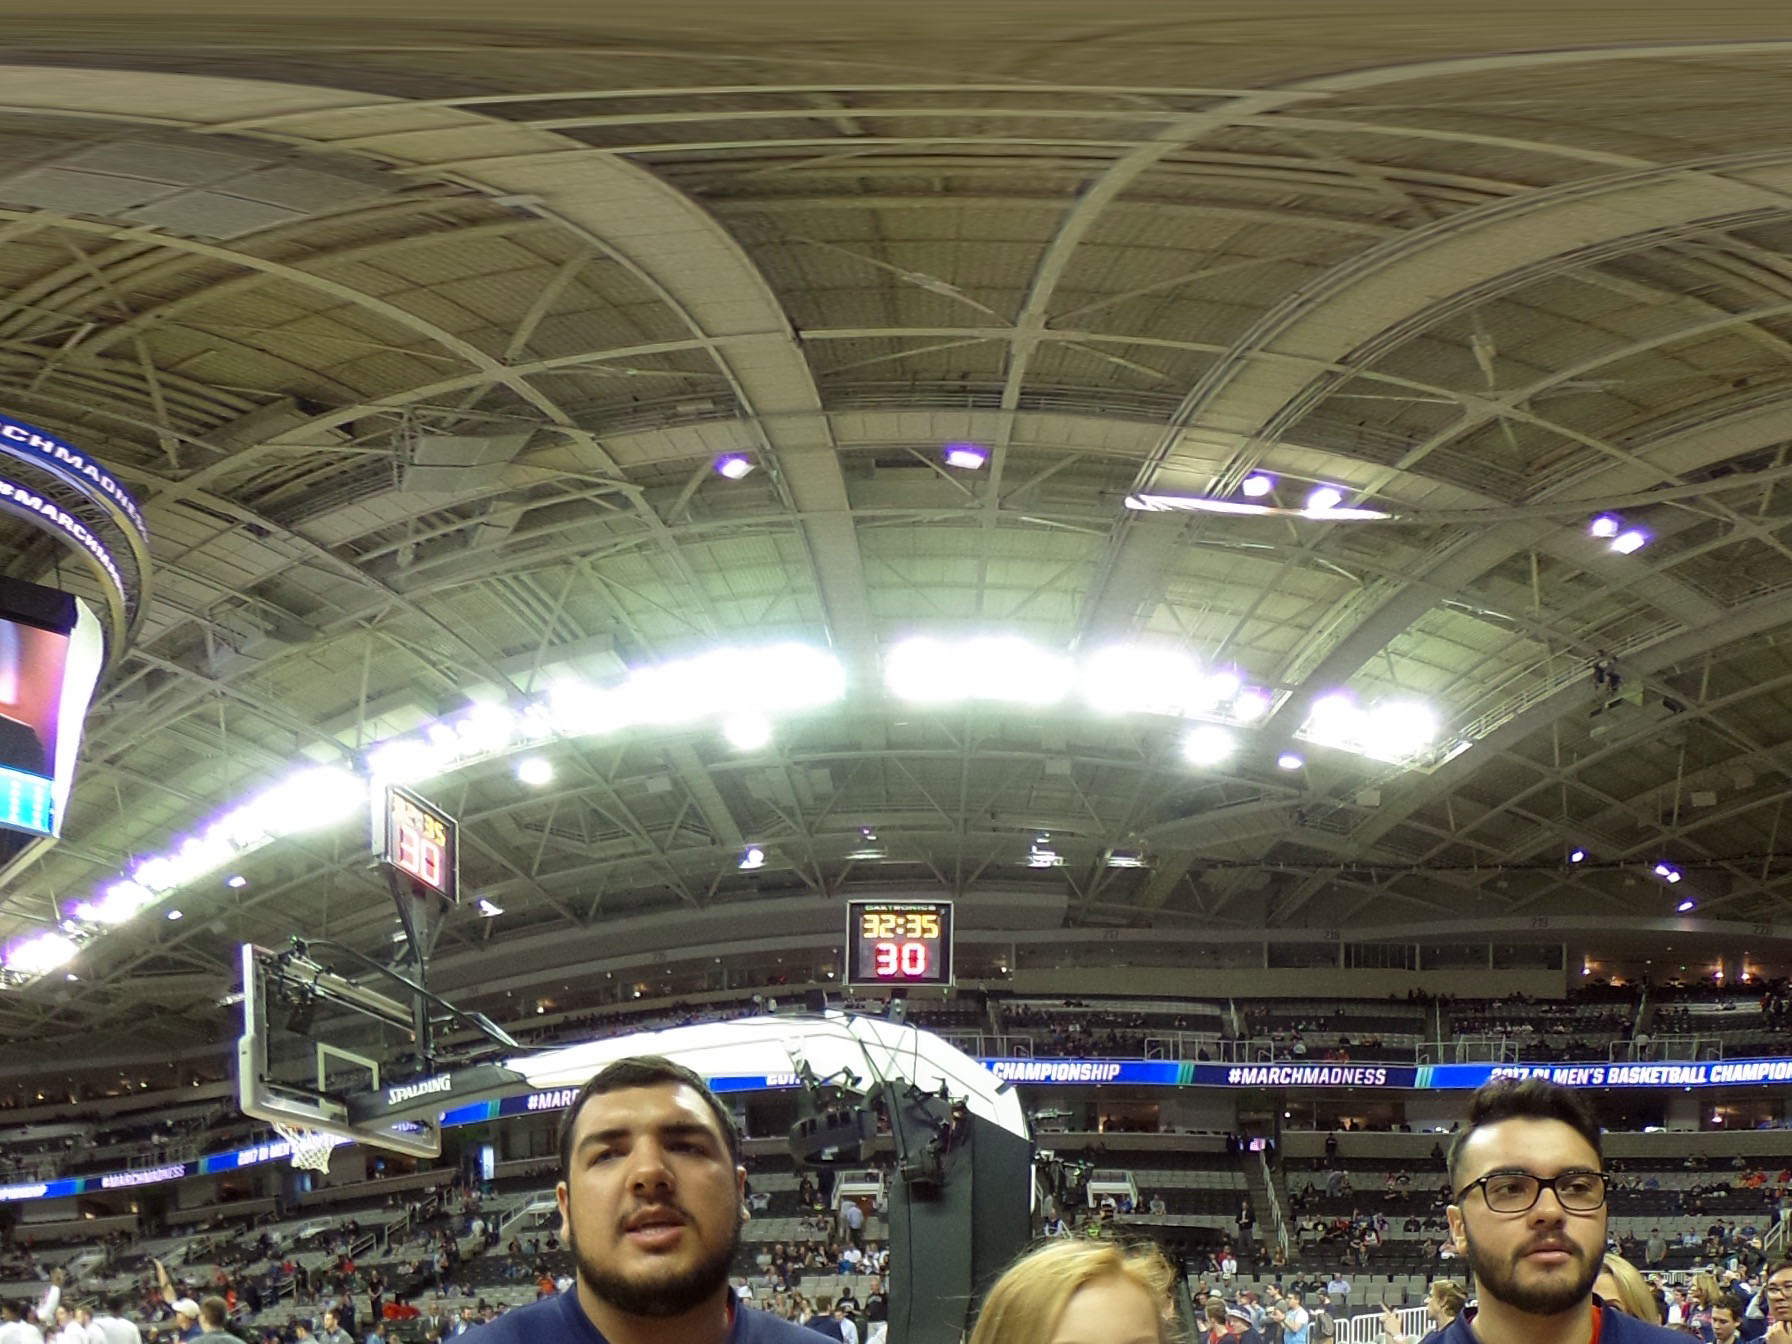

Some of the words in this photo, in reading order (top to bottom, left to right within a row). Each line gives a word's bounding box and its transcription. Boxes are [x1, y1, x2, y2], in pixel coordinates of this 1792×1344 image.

[398, 824, 440, 887] 30
[863, 914, 939, 939] 32:35
[876, 942, 926, 976] 30
[992, 1062, 1121, 1082] CHAMPIONSHIP
[1227, 1066, 1387, 1086] #MARCHMADNESS
[1553, 1066, 1604, 1085] MEN'S
[1607, 1065, 1708, 1085] BASKETBALL
[388, 1073, 452, 1106] SPALDING
